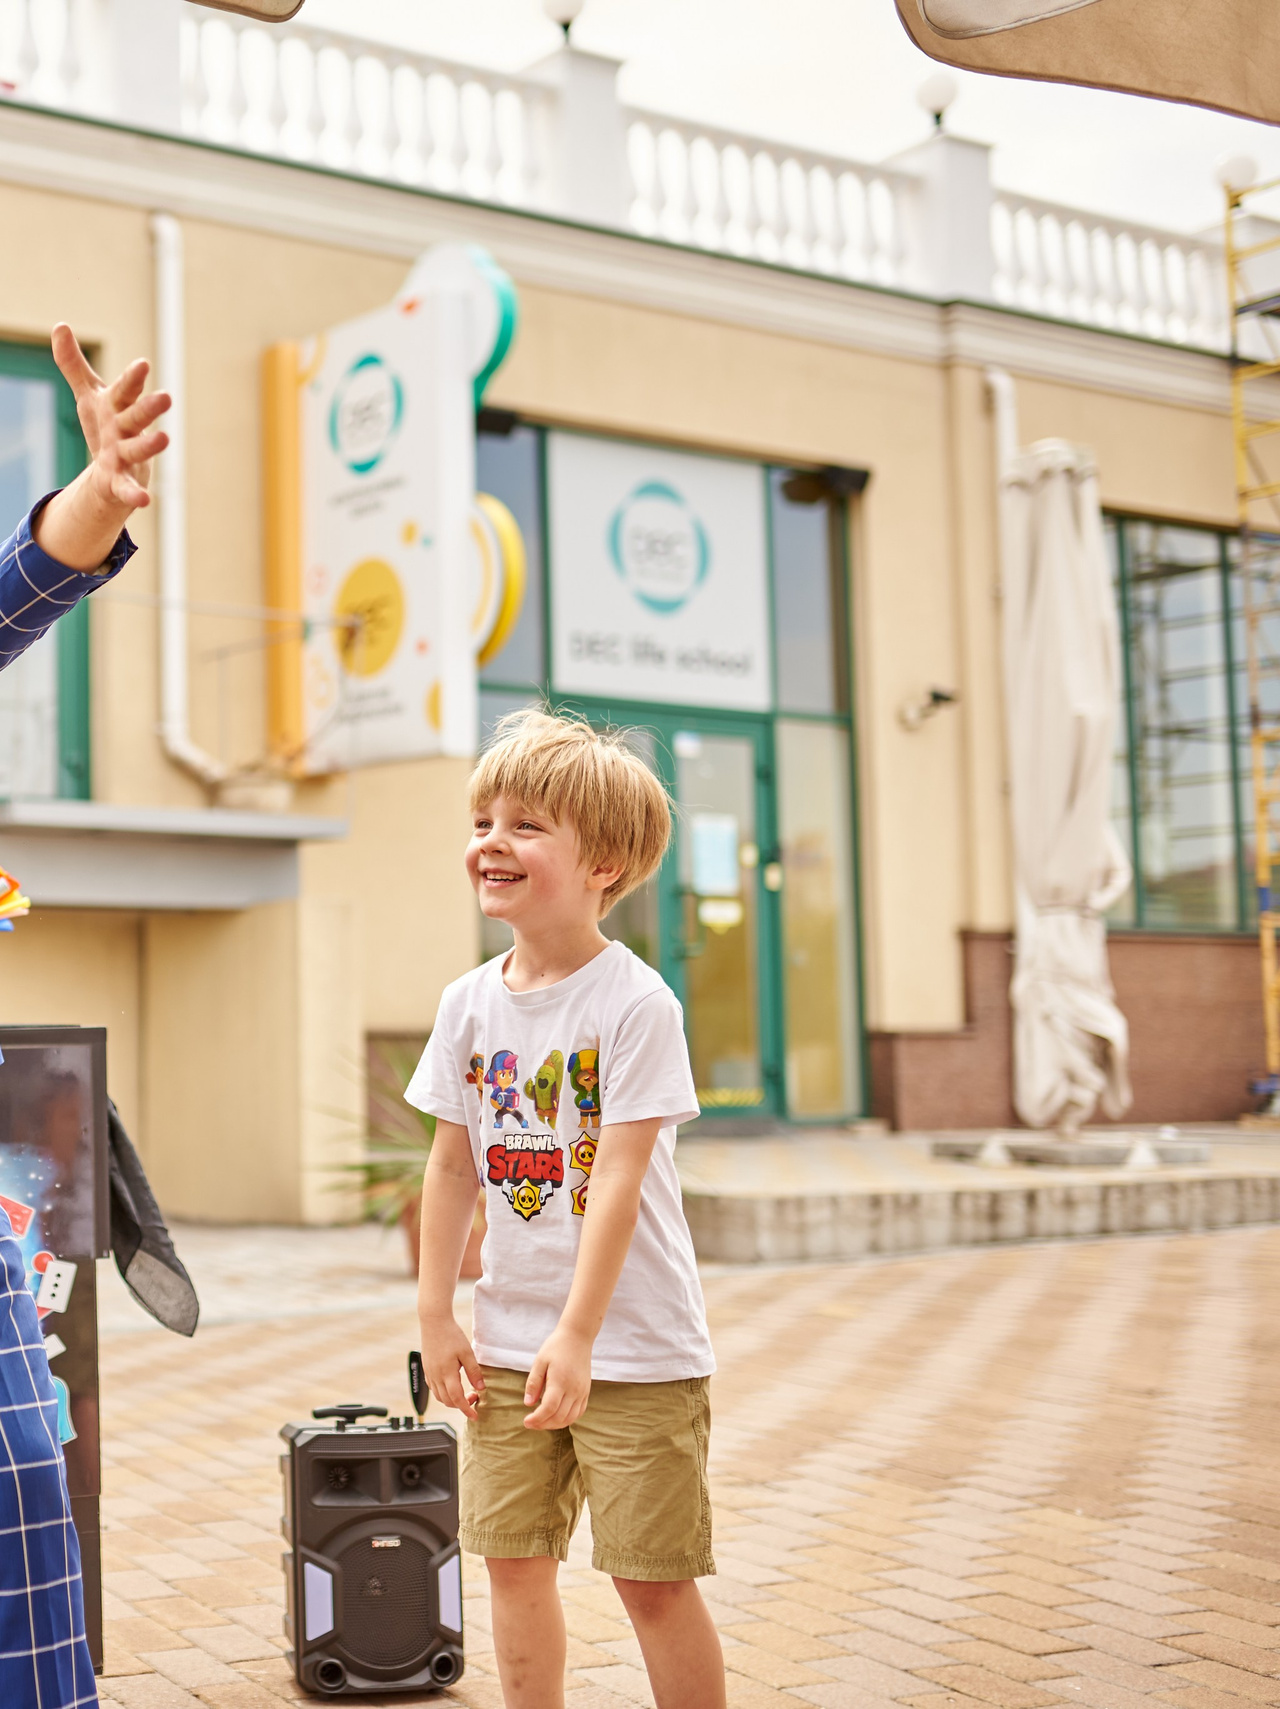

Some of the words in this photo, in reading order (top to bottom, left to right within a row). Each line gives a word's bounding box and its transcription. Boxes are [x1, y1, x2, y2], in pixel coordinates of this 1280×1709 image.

[677, 644, 752, 676] school
[505, 1135, 556, 1152] BRAWL
[487, 1144, 564, 1183] STARS
